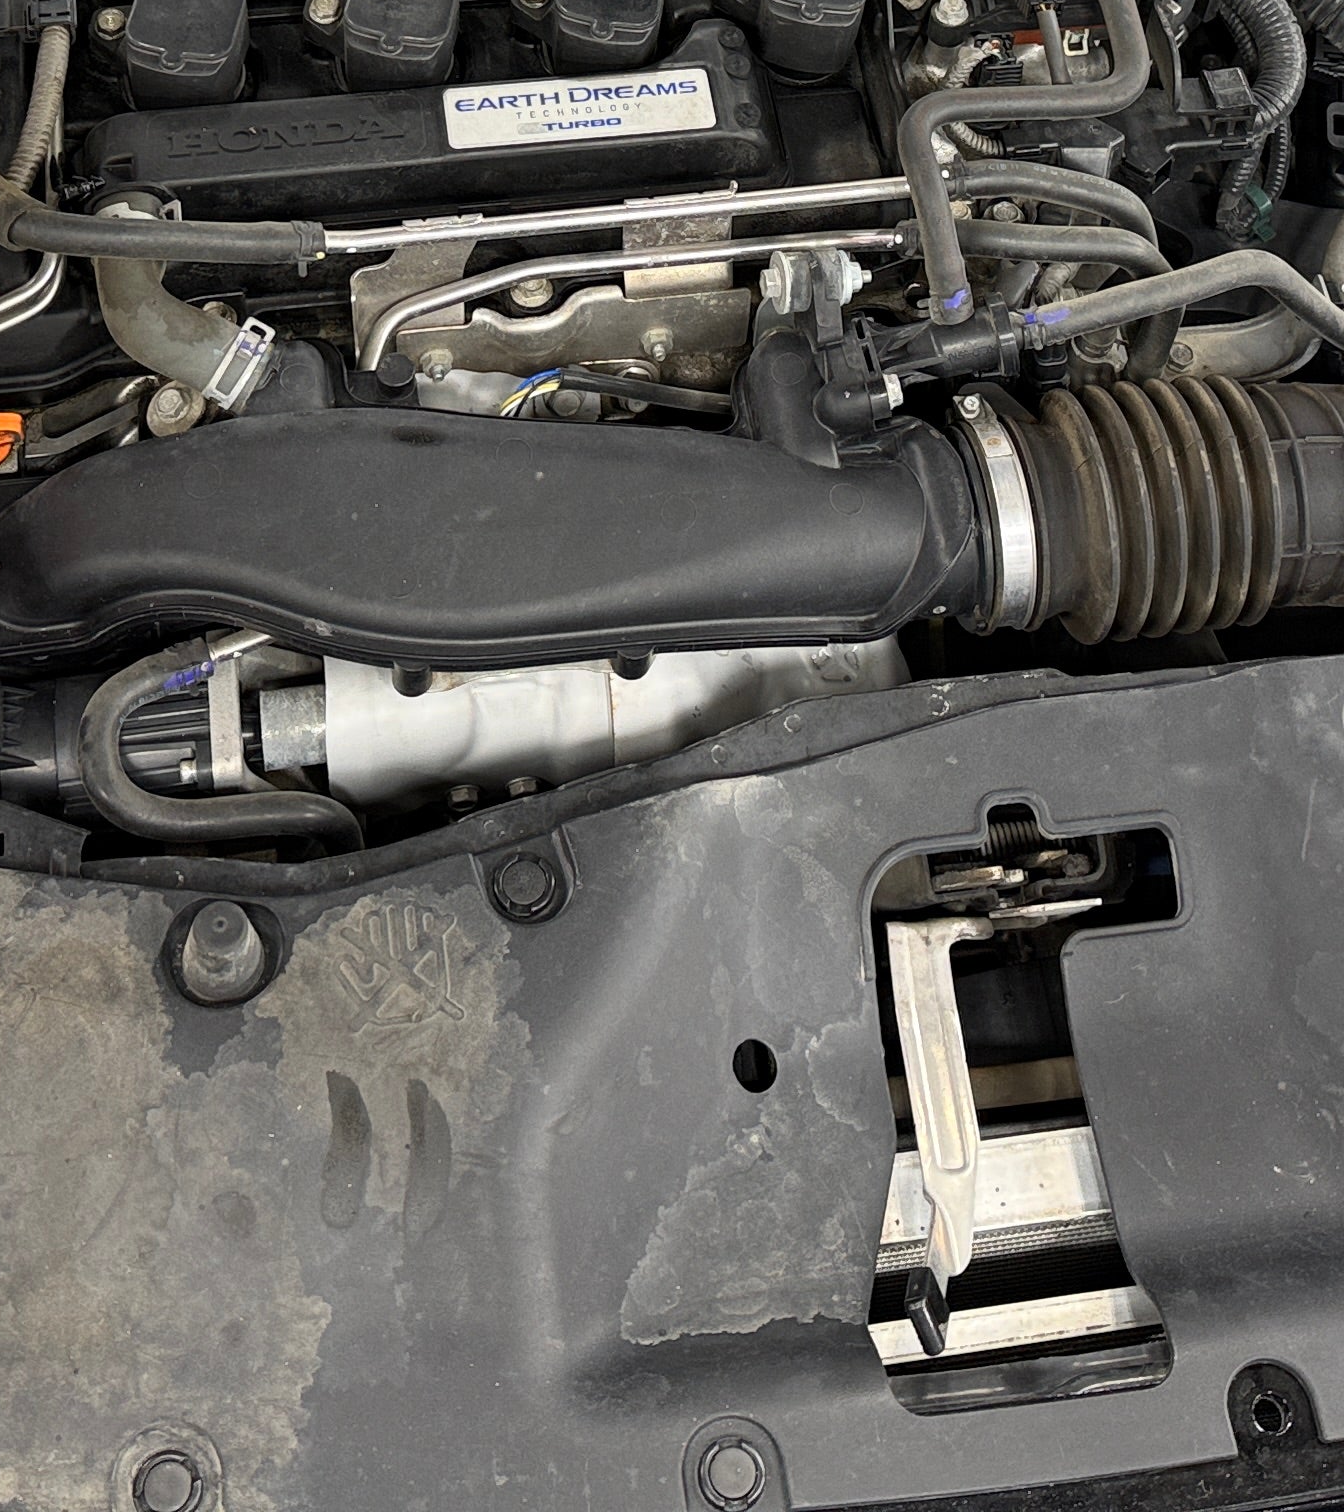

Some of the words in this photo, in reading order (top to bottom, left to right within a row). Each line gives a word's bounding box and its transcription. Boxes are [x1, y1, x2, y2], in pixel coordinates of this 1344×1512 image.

[455, 92, 560, 112] EARTH
[568, 80, 698, 104] DREAMS
[516, 102, 643, 120] TECHNOLOGY
[542, 117, 622, 132] TURBO
[167, 119, 405, 158] HONDA
